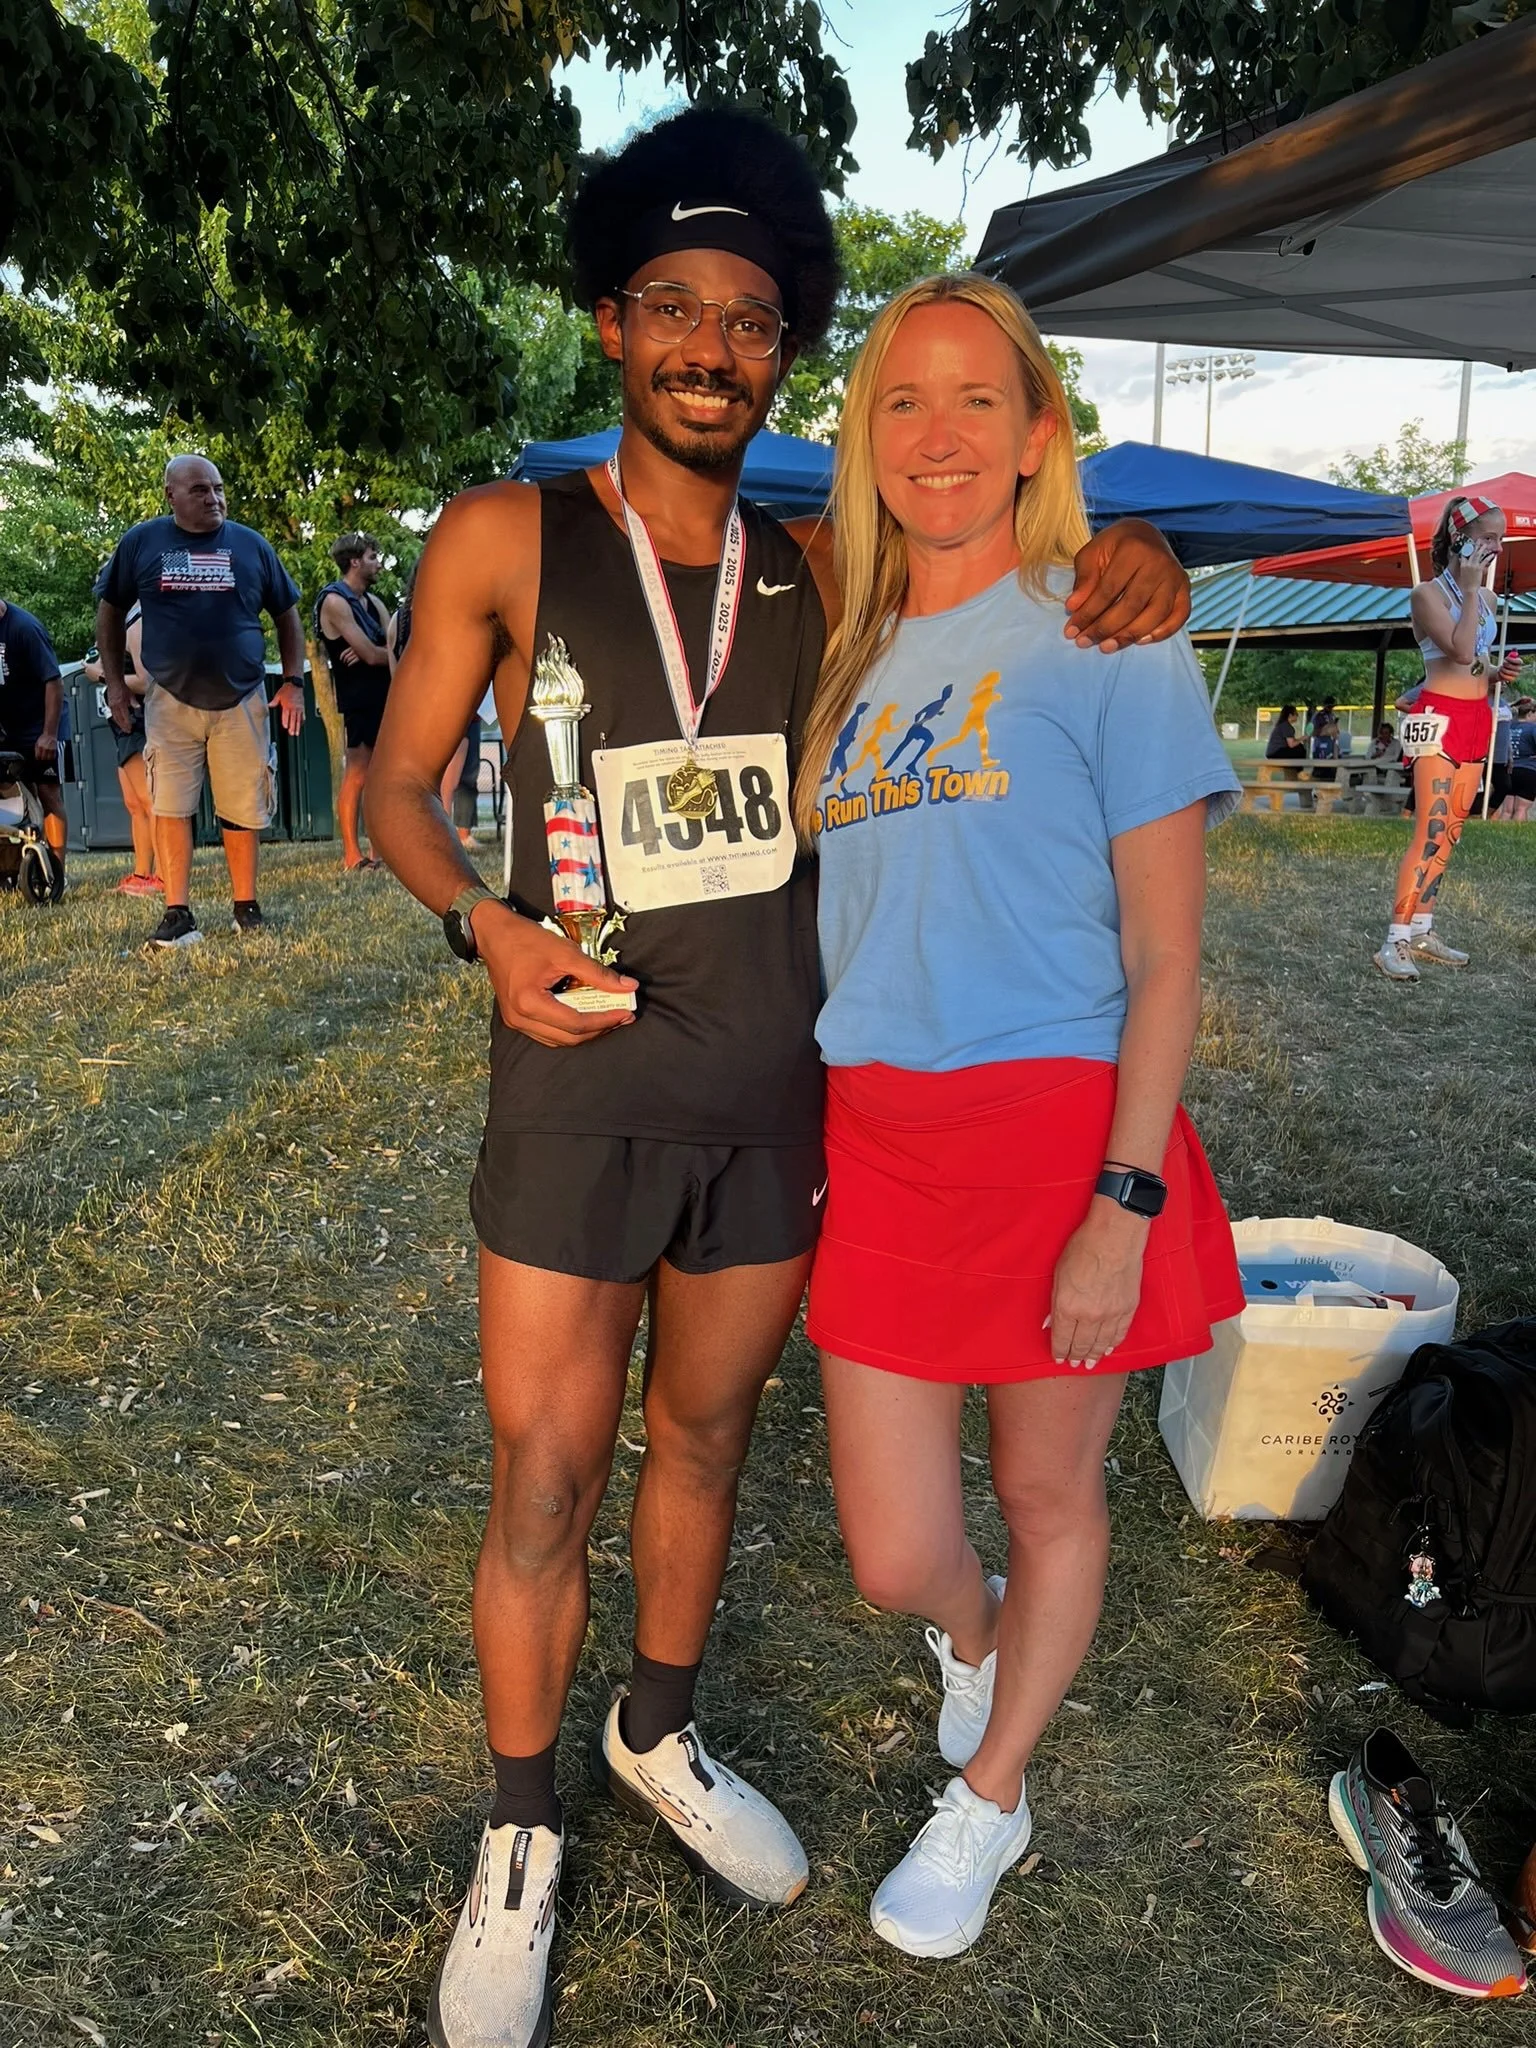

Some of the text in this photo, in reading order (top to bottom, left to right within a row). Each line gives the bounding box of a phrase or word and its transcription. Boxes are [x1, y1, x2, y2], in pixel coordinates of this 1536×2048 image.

[730, 523, 740, 546] 2025
[724, 559, 738, 586] 2025
[718, 602, 731, 633] 2025
[825, 793, 868, 832] Run
[870, 774, 923, 816] This
[926, 765, 1010, 804] Town
[1261, 1435, 1323, 1445] CARIBE
